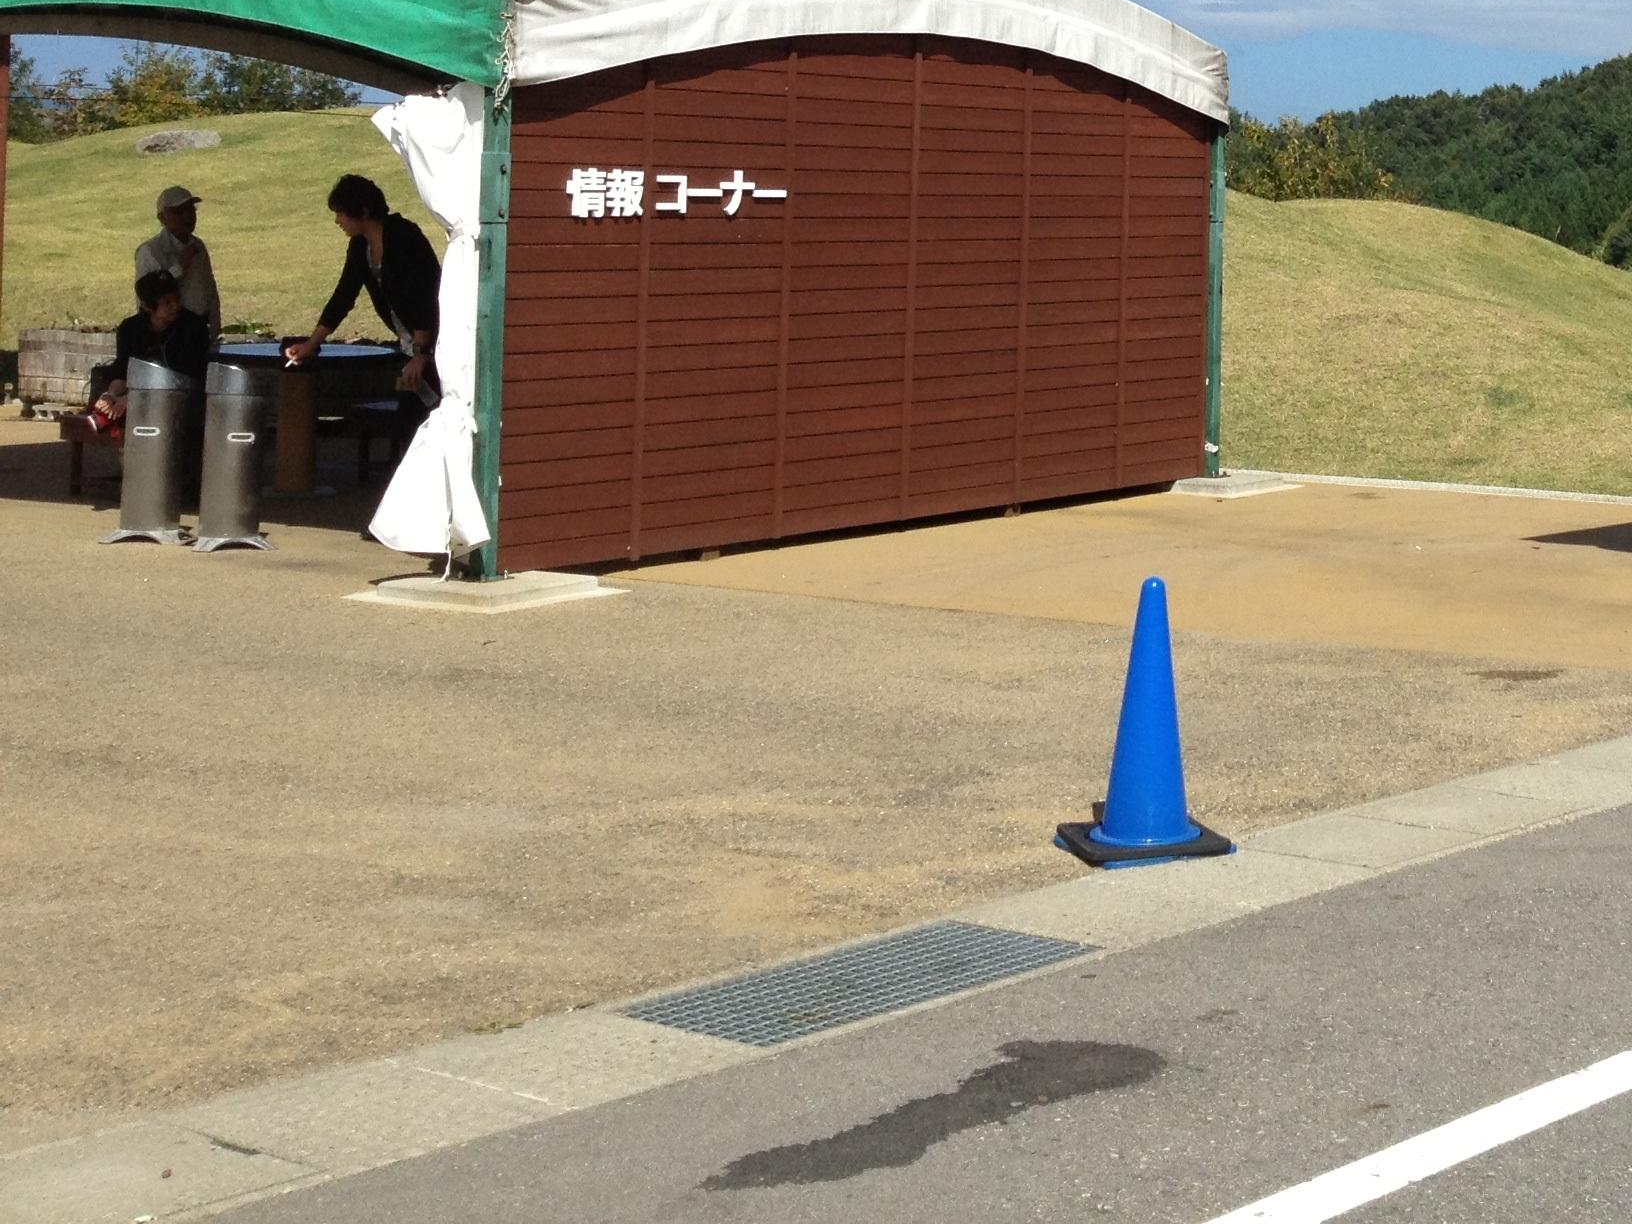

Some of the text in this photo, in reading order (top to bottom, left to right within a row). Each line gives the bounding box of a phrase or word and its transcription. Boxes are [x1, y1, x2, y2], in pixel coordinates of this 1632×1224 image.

[566, 167, 788, 218] 情報コーナー
